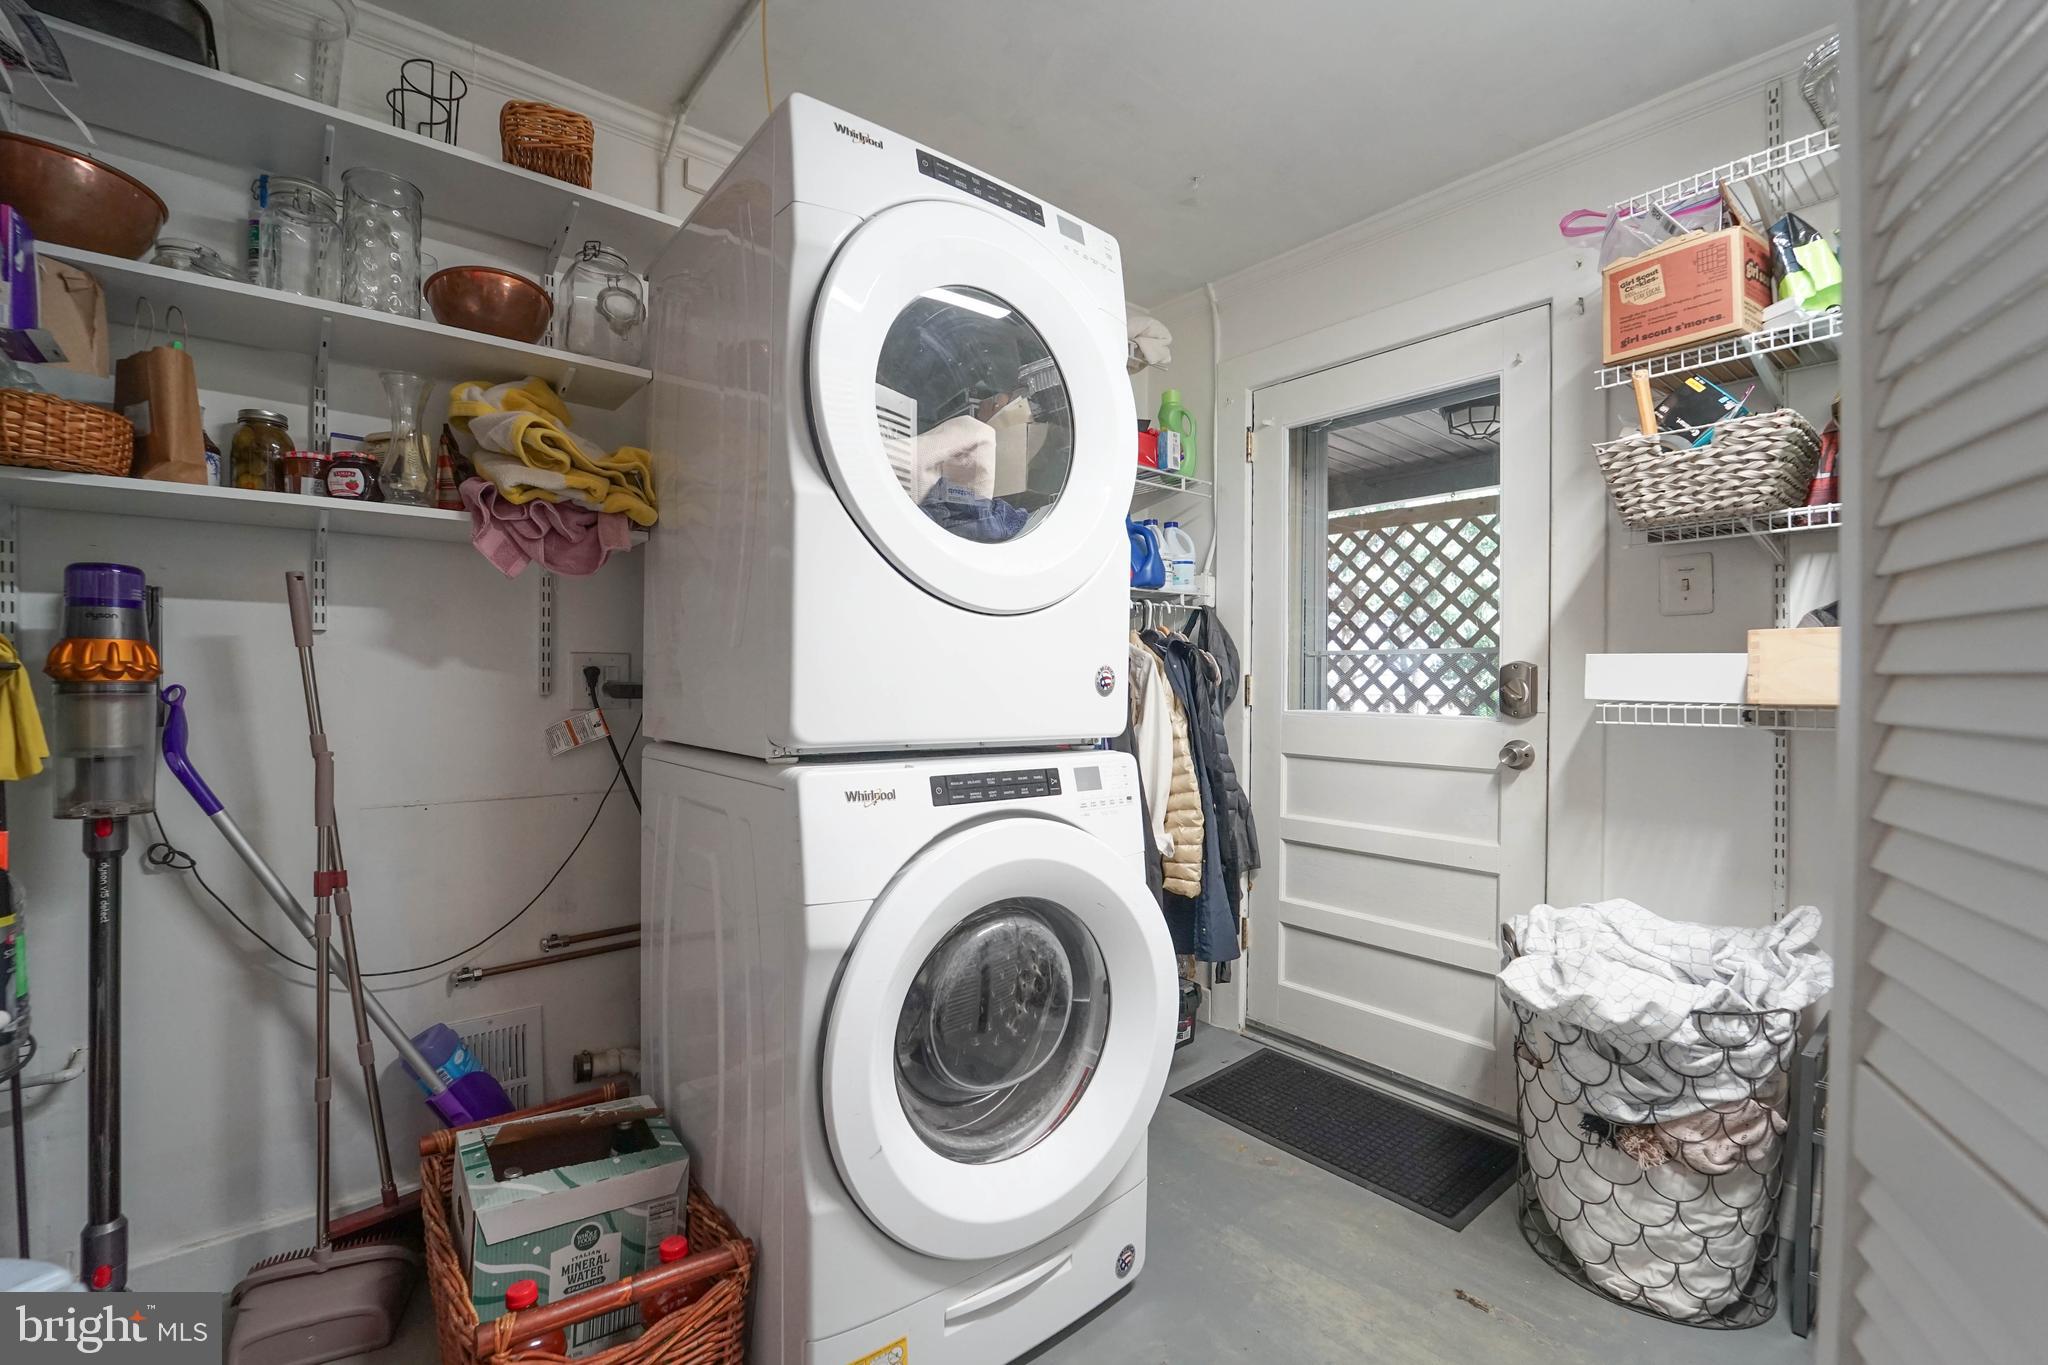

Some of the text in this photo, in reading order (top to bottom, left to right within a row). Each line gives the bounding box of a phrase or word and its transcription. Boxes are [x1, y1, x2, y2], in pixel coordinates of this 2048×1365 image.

[833, 121, 884, 150] Whirlpool
[1620, 269, 1659, 289] Girl Scout
[1624, 276, 1656, 293] Cookies
[1620, 334, 1640, 349] girl
[1641, 326, 1673, 341] scout
[844, 788, 897, 805] Whirlpool
[97, 862, 110, 885] dyson
[561, 1253, 611, 1277] MINERAL
[571, 1249, 602, 1262] ITALIAN
[567, 1265, 604, 1285] WATER
